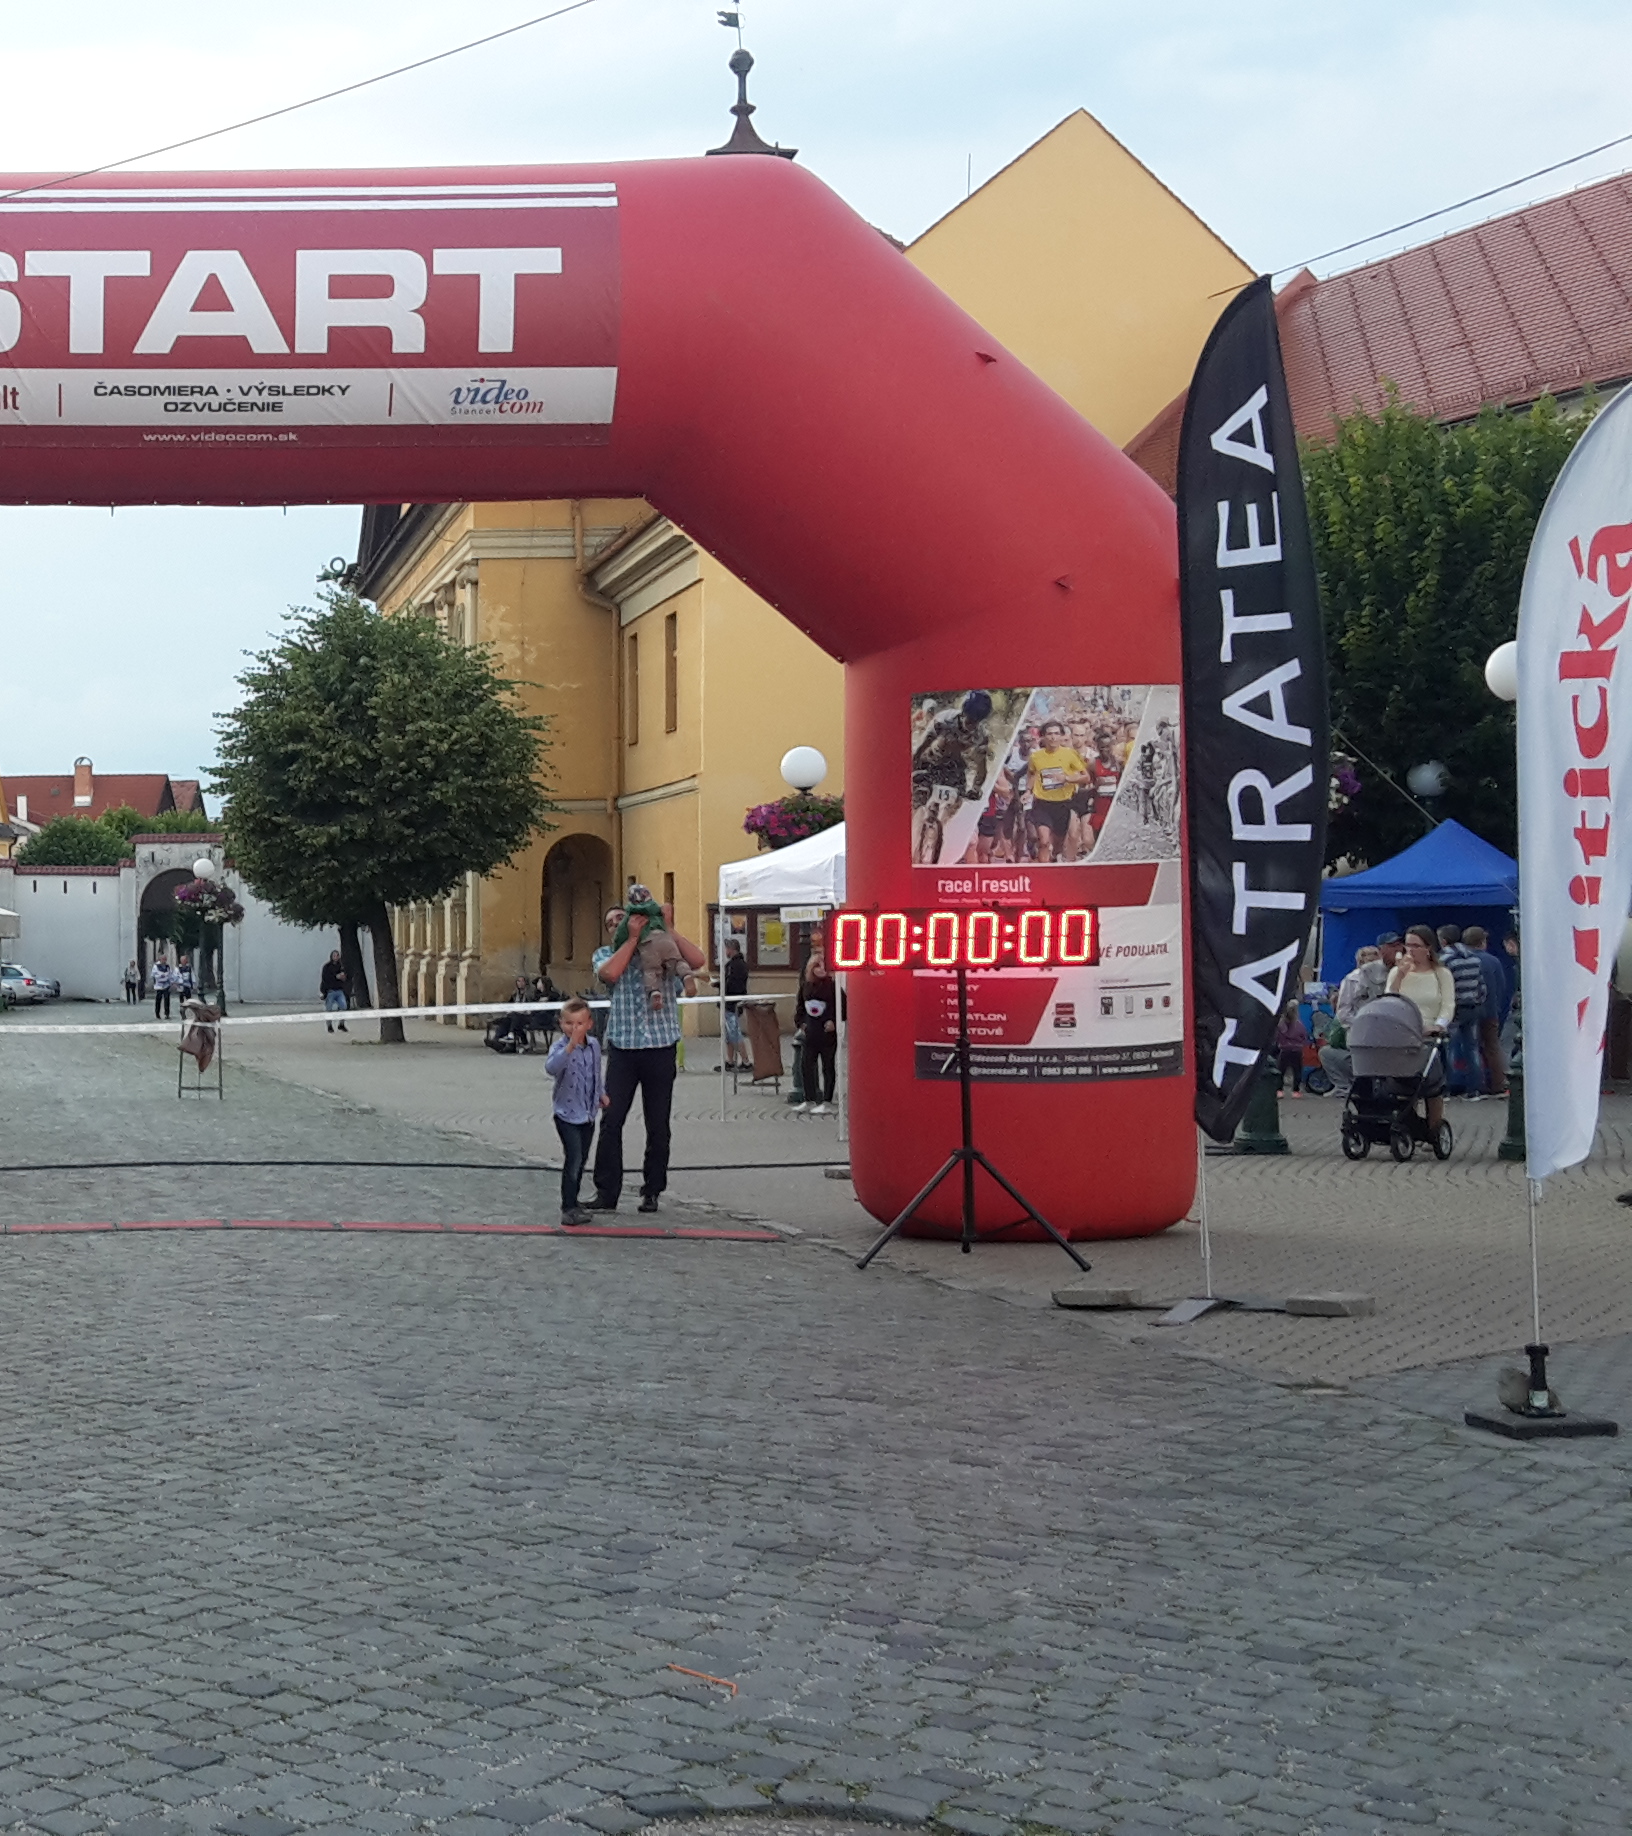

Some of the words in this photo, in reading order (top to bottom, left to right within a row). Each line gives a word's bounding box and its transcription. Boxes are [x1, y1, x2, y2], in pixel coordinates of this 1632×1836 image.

[93, 381, 219, 398] ČASOMIERA
[237, 378, 352, 397] VÝSLEDKY
[163, 397, 284, 413] OZVUČENIE
[142, 431, 298, 443] www.videocom.sk
[1210, 383, 1314, 1089] TATRATEA
[834, 909, 1093, 967] 00:00:00
